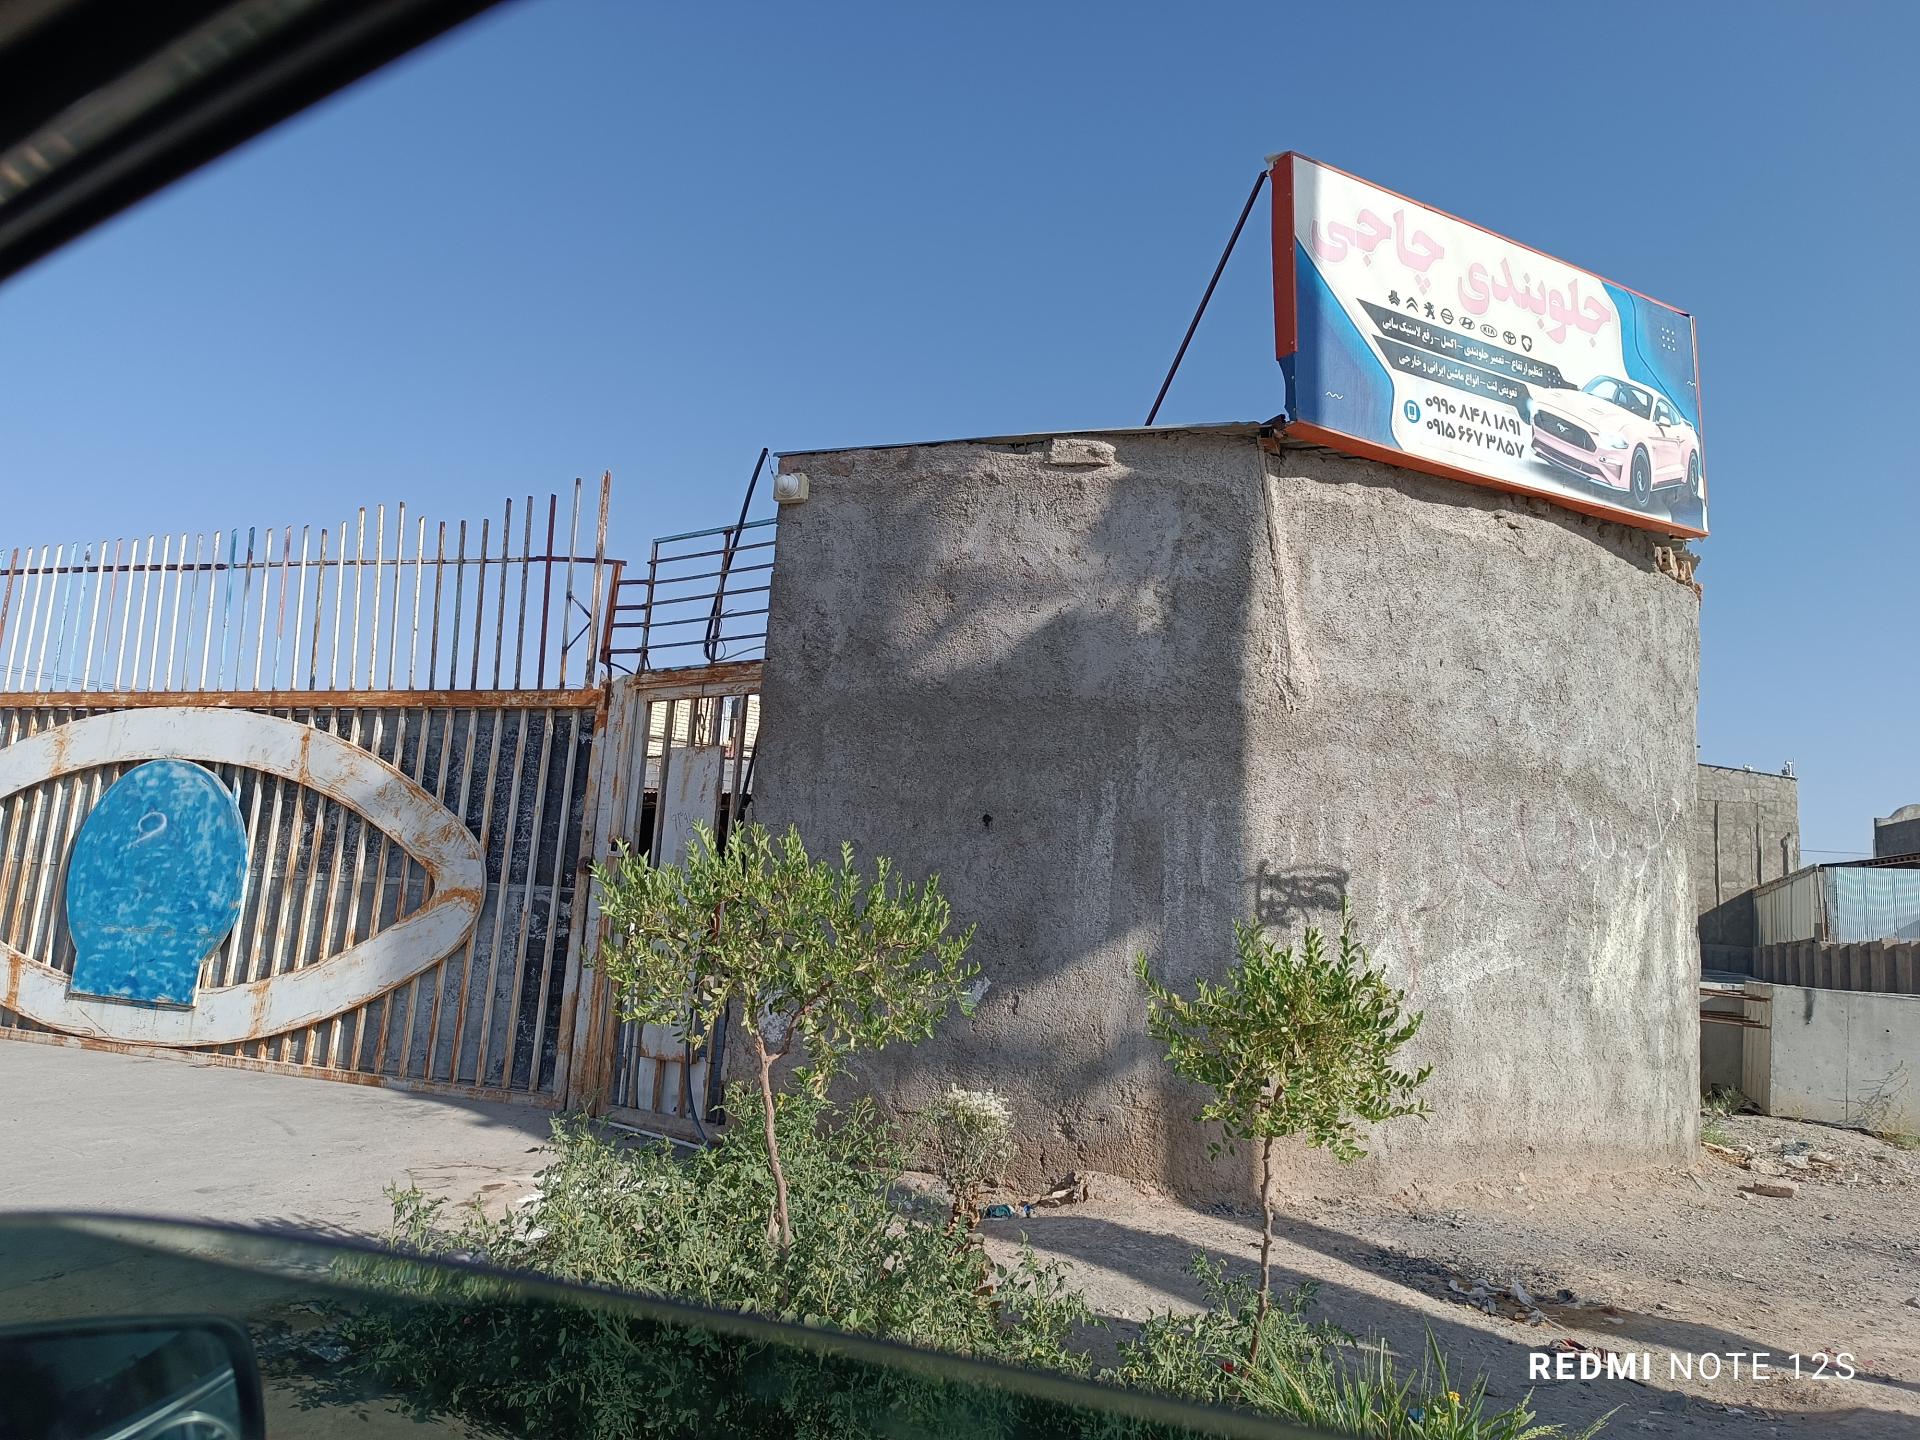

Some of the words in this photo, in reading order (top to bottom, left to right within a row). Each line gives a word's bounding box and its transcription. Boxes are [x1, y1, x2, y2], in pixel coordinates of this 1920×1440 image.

[1311, 208, 1445, 296] چاجی
[1457, 257, 1612, 348] جلوبندی
[1398, 322, 1421, 337] لاستیک
[1421, 329, 1434, 344] رفع
[1398, 354, 1422, 368] خارجی
[1463, 346, 1489, 363] جلوبندی
[1490, 355, 1505, 365] تعمیر
[1427, 361, 1446, 377] ایرانی
[1446, 368, 1465, 381] ماشین
[1511, 359, 1528, 375] ارتفاع
[1528, 365, 1543, 378] تنظیم
[1465, 374, 1480, 388] انواع
[1486, 380, 1498, 392] لنت
[1497, 387, 1518, 399] تعویض
[1425, 395, 1456, 415] ۰۹۹۰
[1459, 404, 1492, 428] ۸۴۸
[1494, 413, 1521, 436] ۱۸۹۱
[1426, 418, 1456, 440] ۰۹۱۵
[1458, 425, 1483, 447] ۶۶۷
[1485, 433, 1525, 459] ۳۸۵۷
